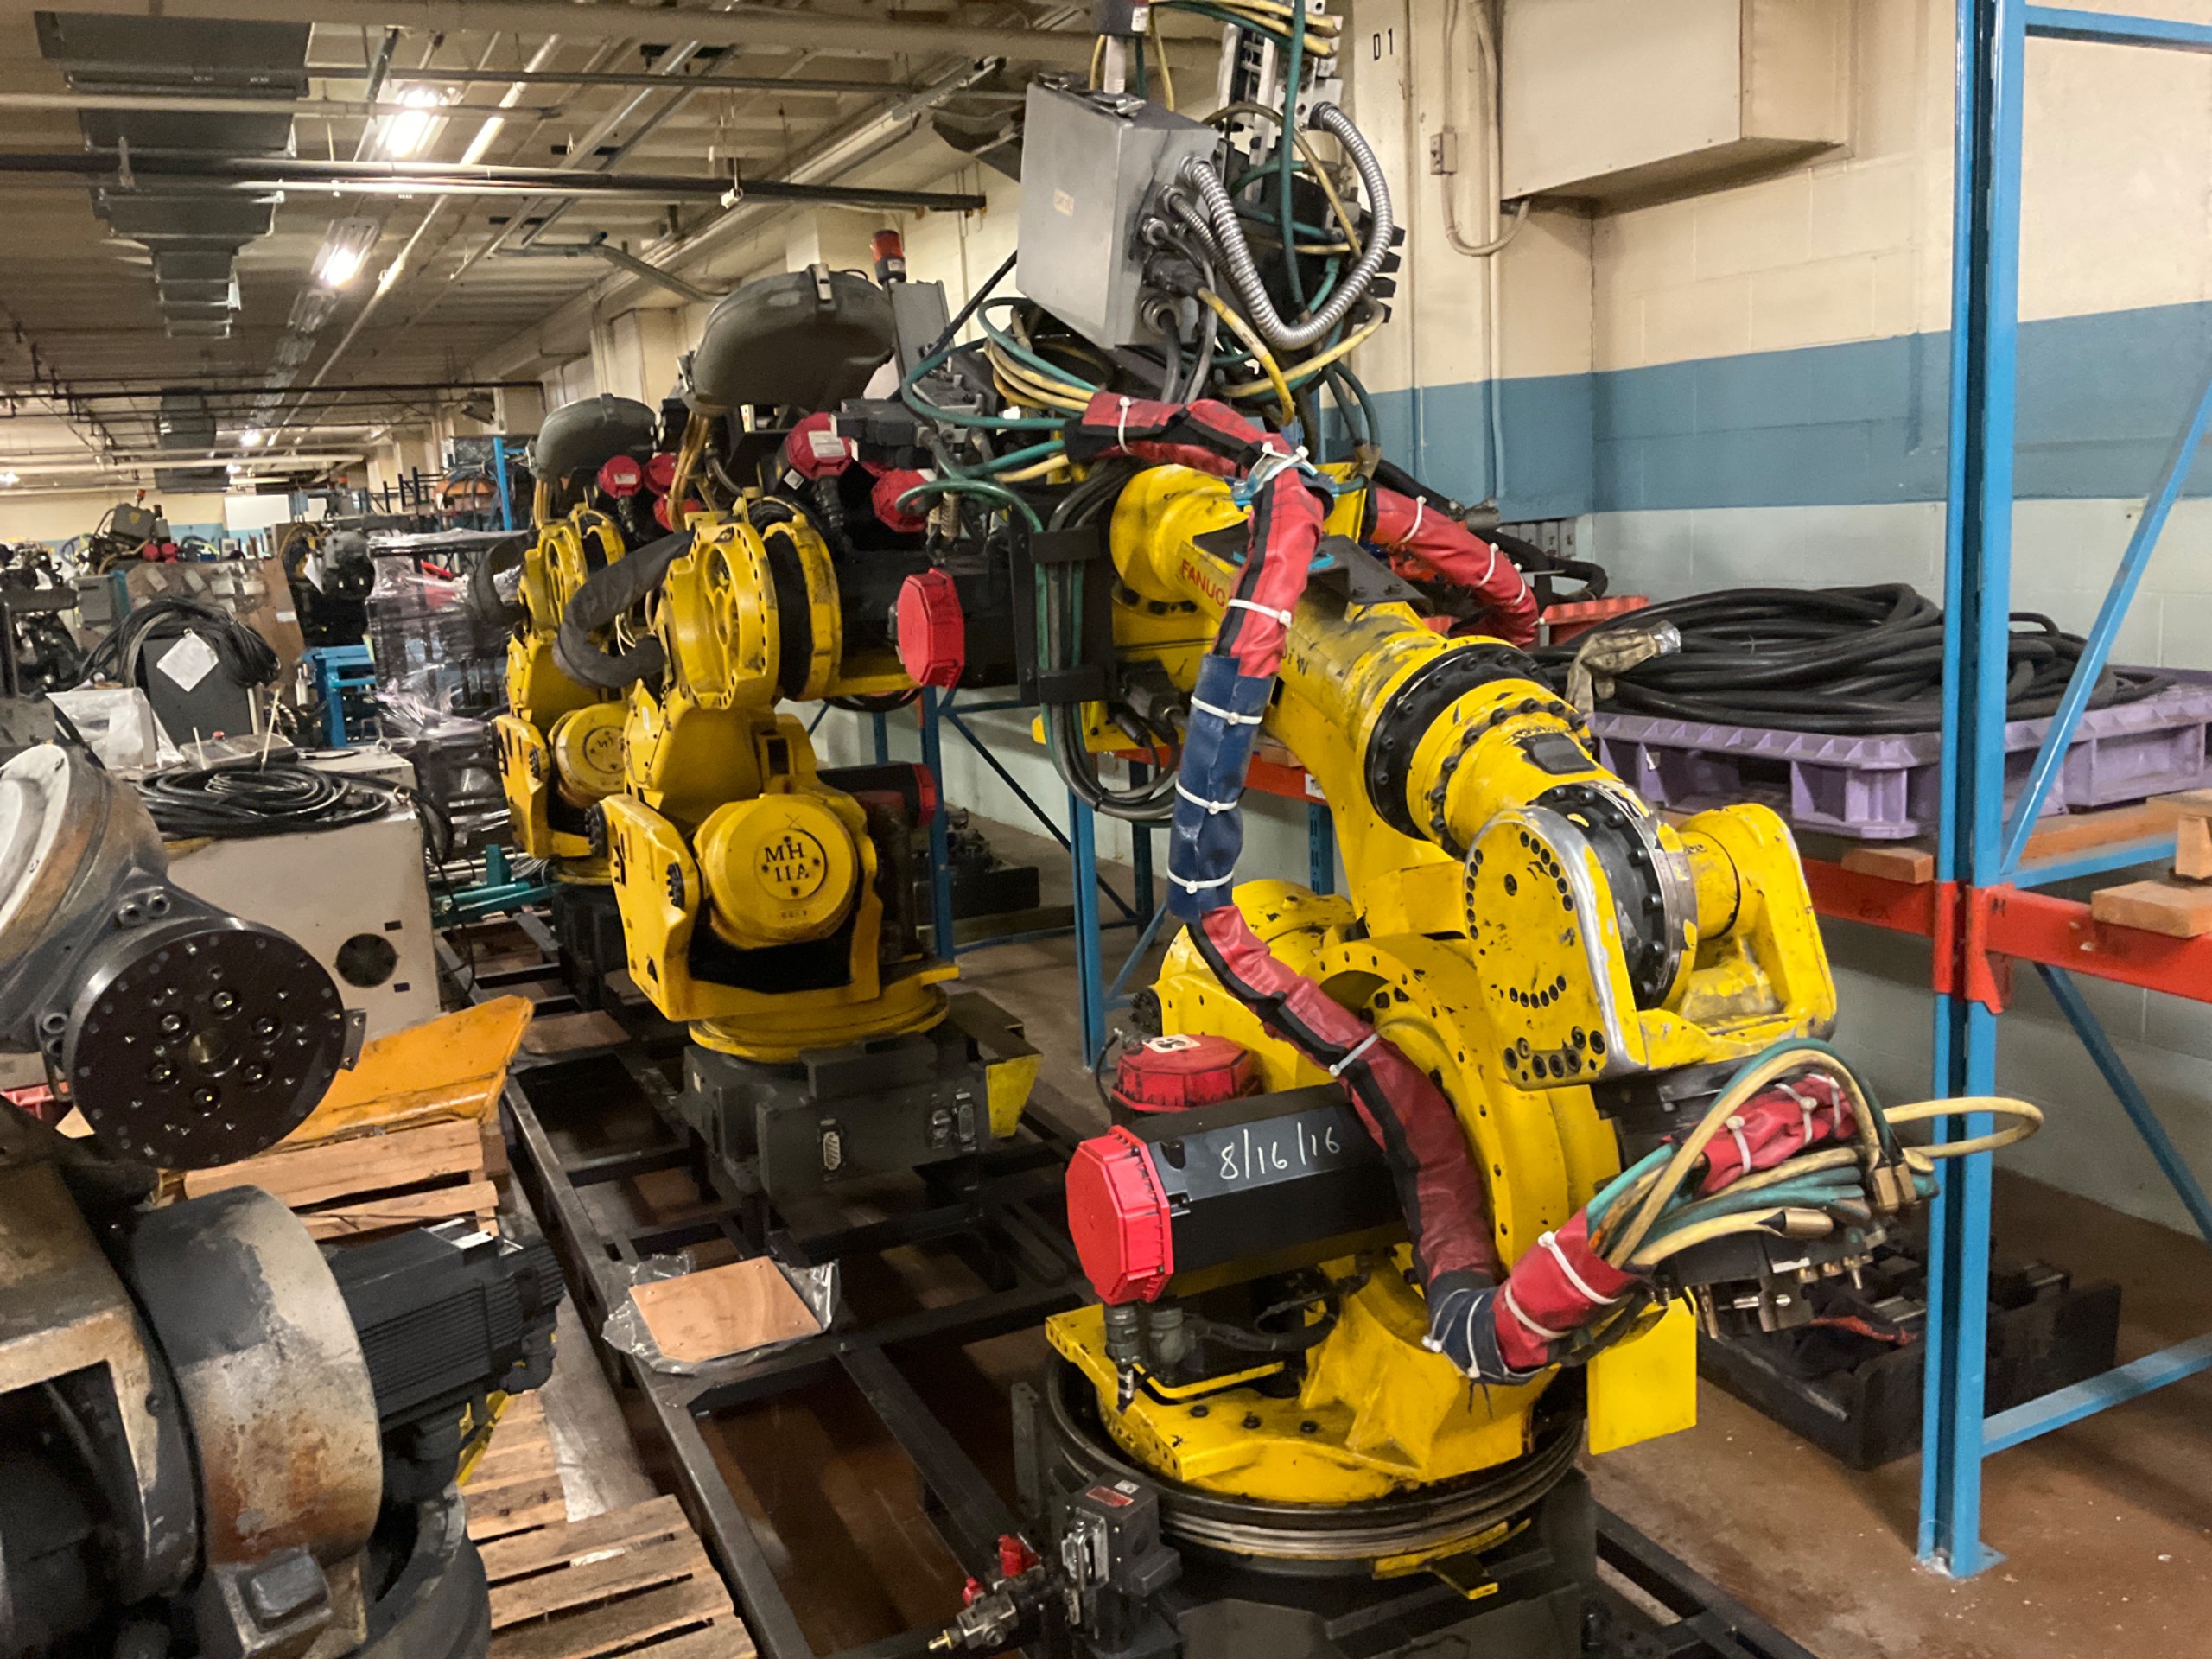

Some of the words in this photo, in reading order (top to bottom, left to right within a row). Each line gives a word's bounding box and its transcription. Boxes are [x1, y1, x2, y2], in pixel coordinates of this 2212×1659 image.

[1180, 557, 1225, 607] FANUC
[764, 842, 804, 862] MH
[1219, 1122, 1340, 1179] 8/16/16
